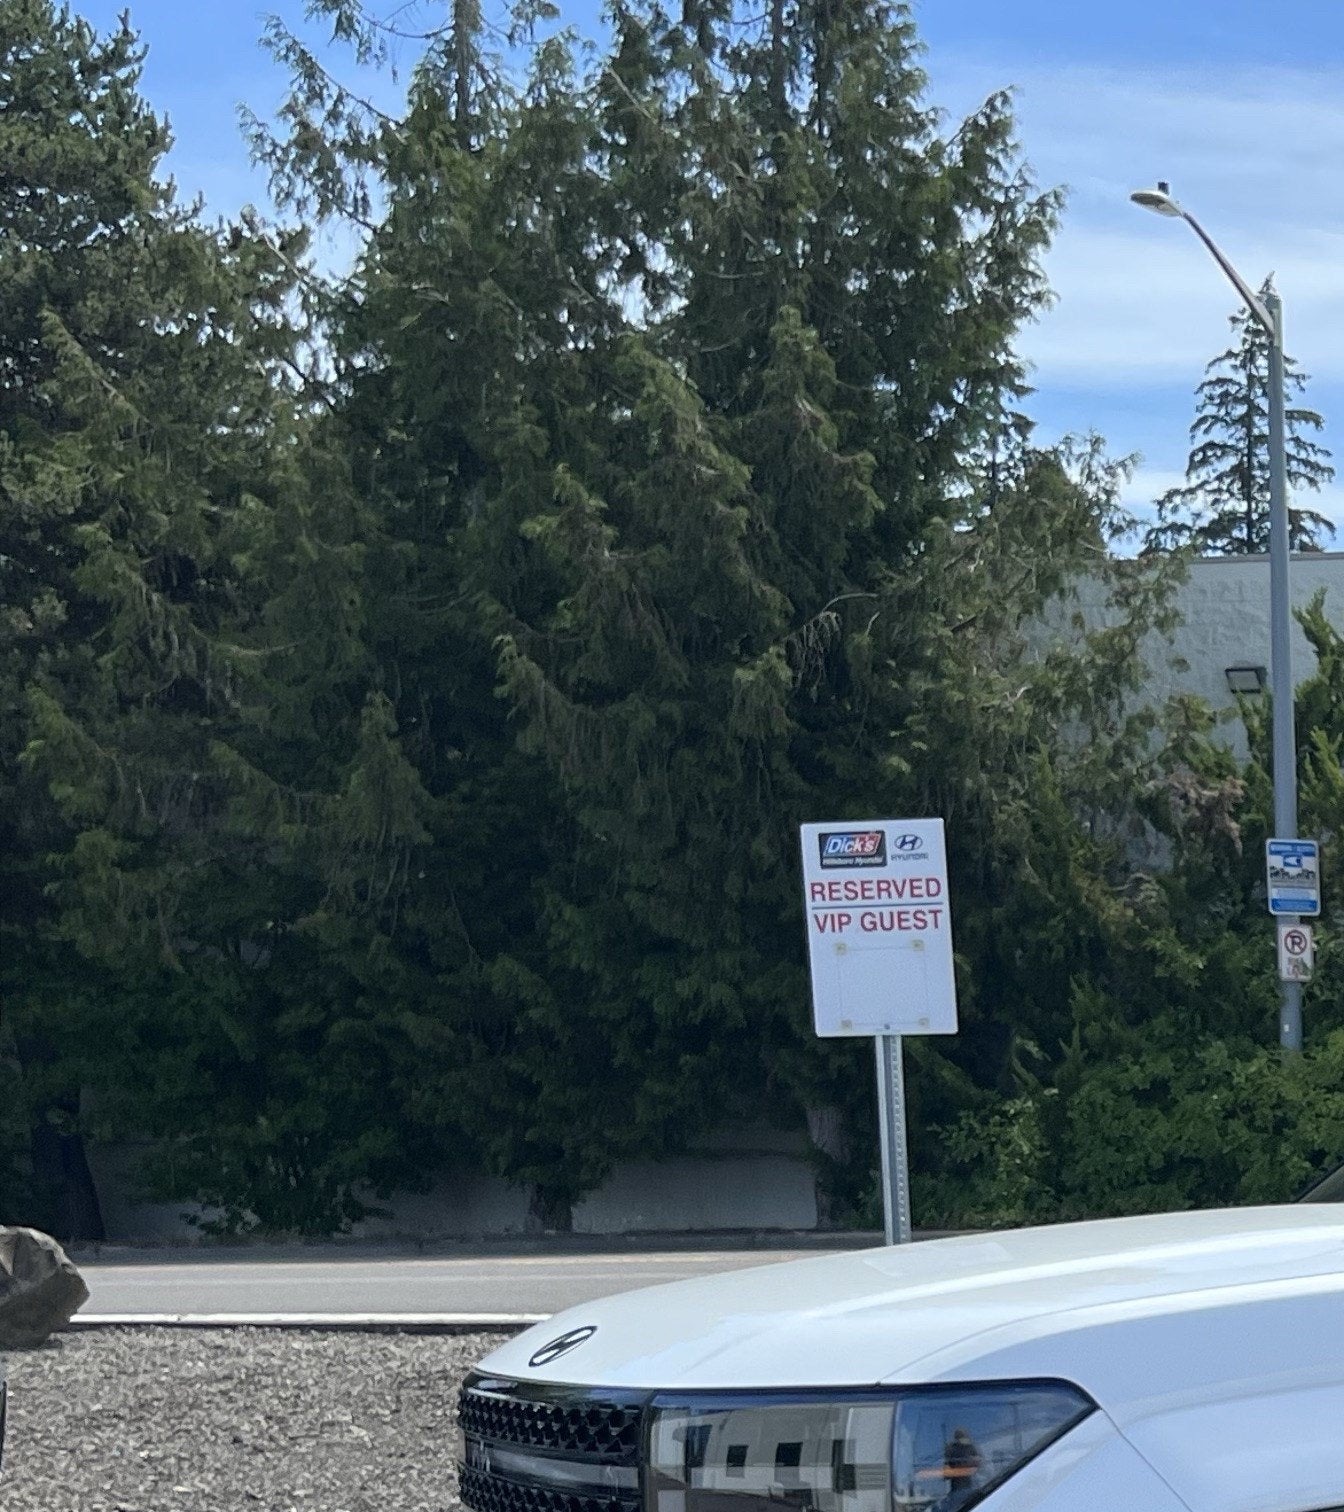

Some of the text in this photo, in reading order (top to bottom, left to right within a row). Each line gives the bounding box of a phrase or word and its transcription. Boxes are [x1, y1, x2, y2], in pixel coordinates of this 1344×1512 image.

[810, 877, 942, 903] RESERVED
[813, 909, 943, 934] VIP GUEST
